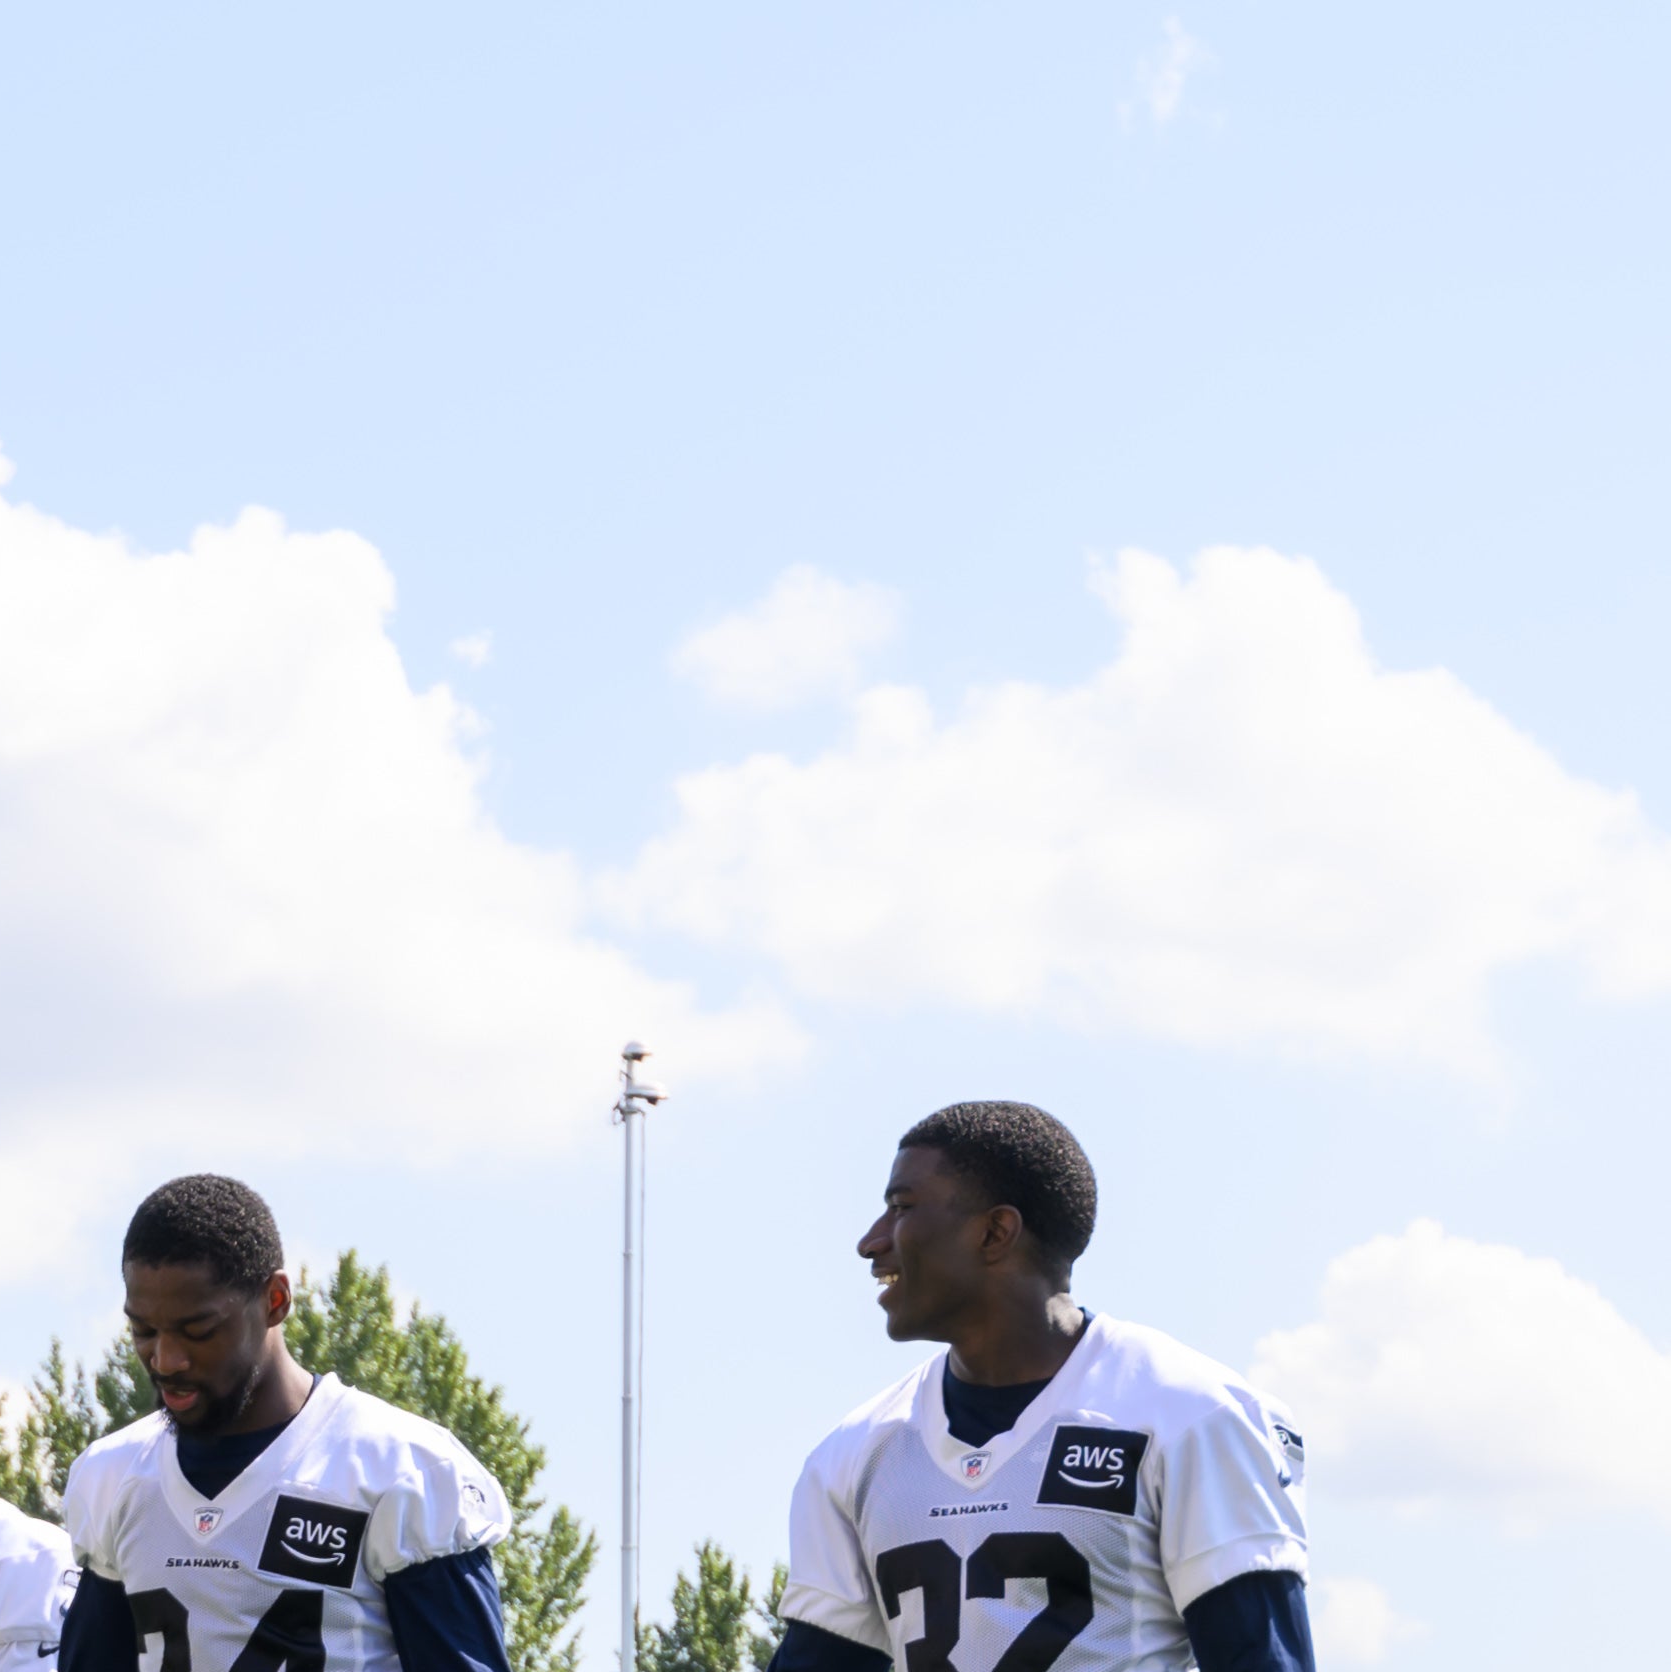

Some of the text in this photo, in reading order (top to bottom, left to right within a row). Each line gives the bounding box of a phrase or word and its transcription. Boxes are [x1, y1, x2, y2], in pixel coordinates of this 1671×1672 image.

[1063, 1442, 1125, 1472] aws
[928, 1501, 1009, 1518] SEAHAWKS
[285, 1516, 348, 1550] aws
[164, 1556, 240, 1570] SEAHAWKS
